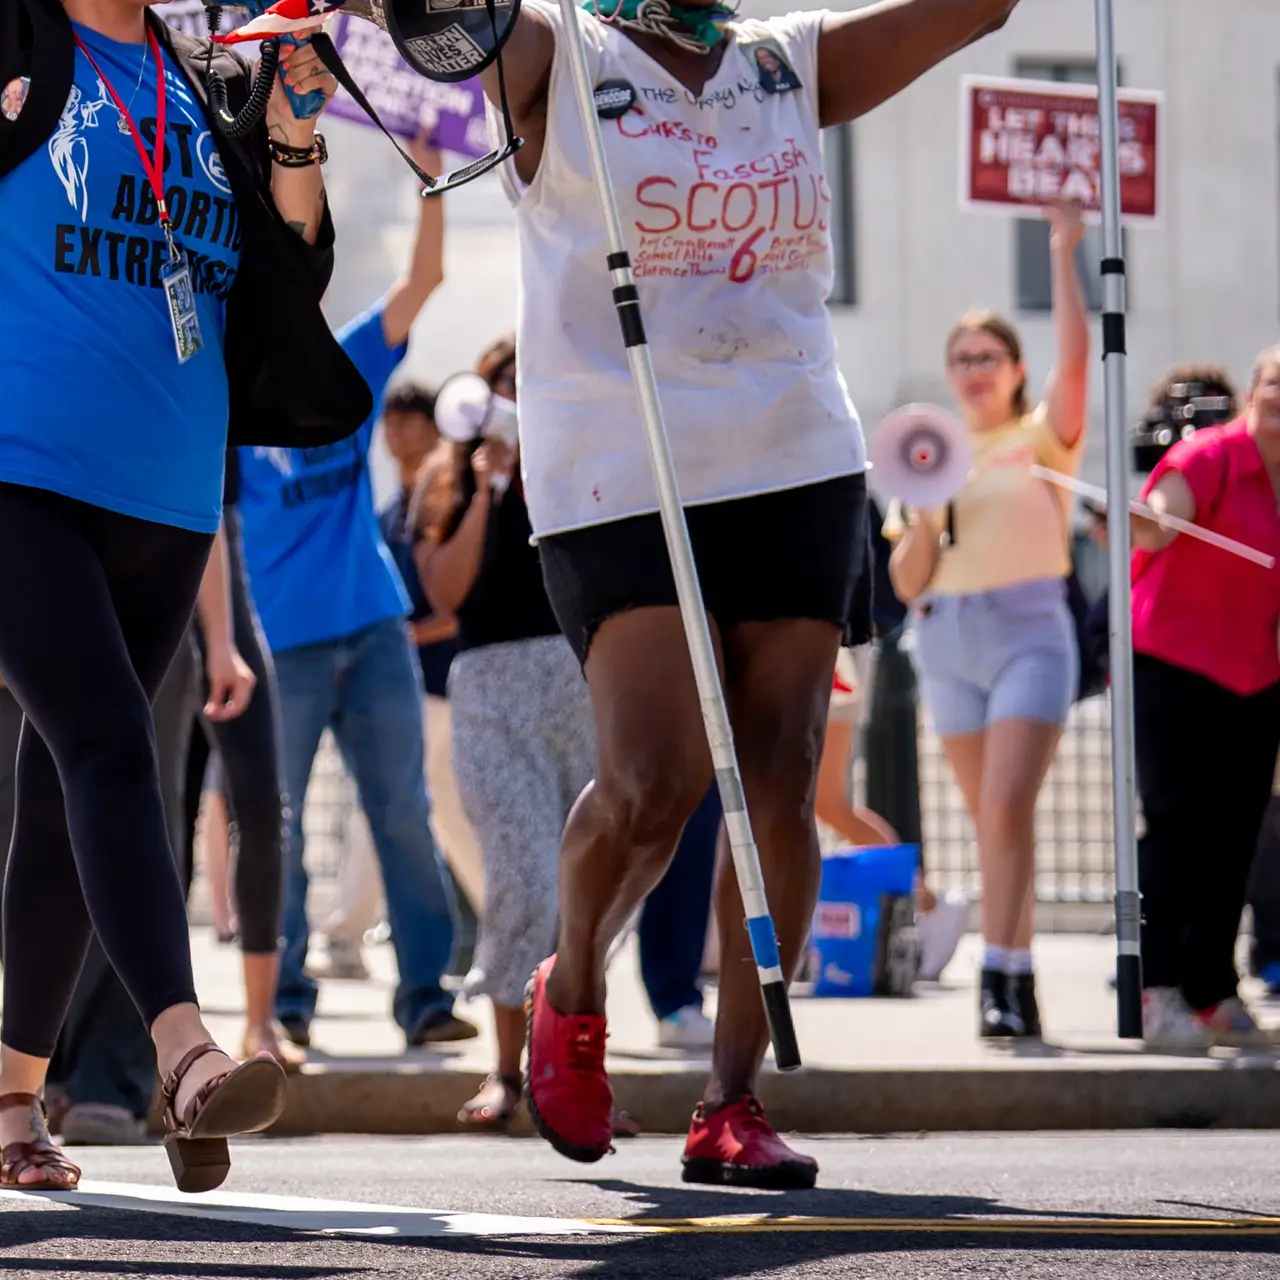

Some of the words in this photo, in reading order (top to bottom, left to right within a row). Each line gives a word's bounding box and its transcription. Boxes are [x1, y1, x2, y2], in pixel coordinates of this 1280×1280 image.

[408, 28, 463, 53] NBORN
[641, 87, 679, 104] THE
[988, 105, 1045, 134] LET
[728, 225, 767, 284] 6
